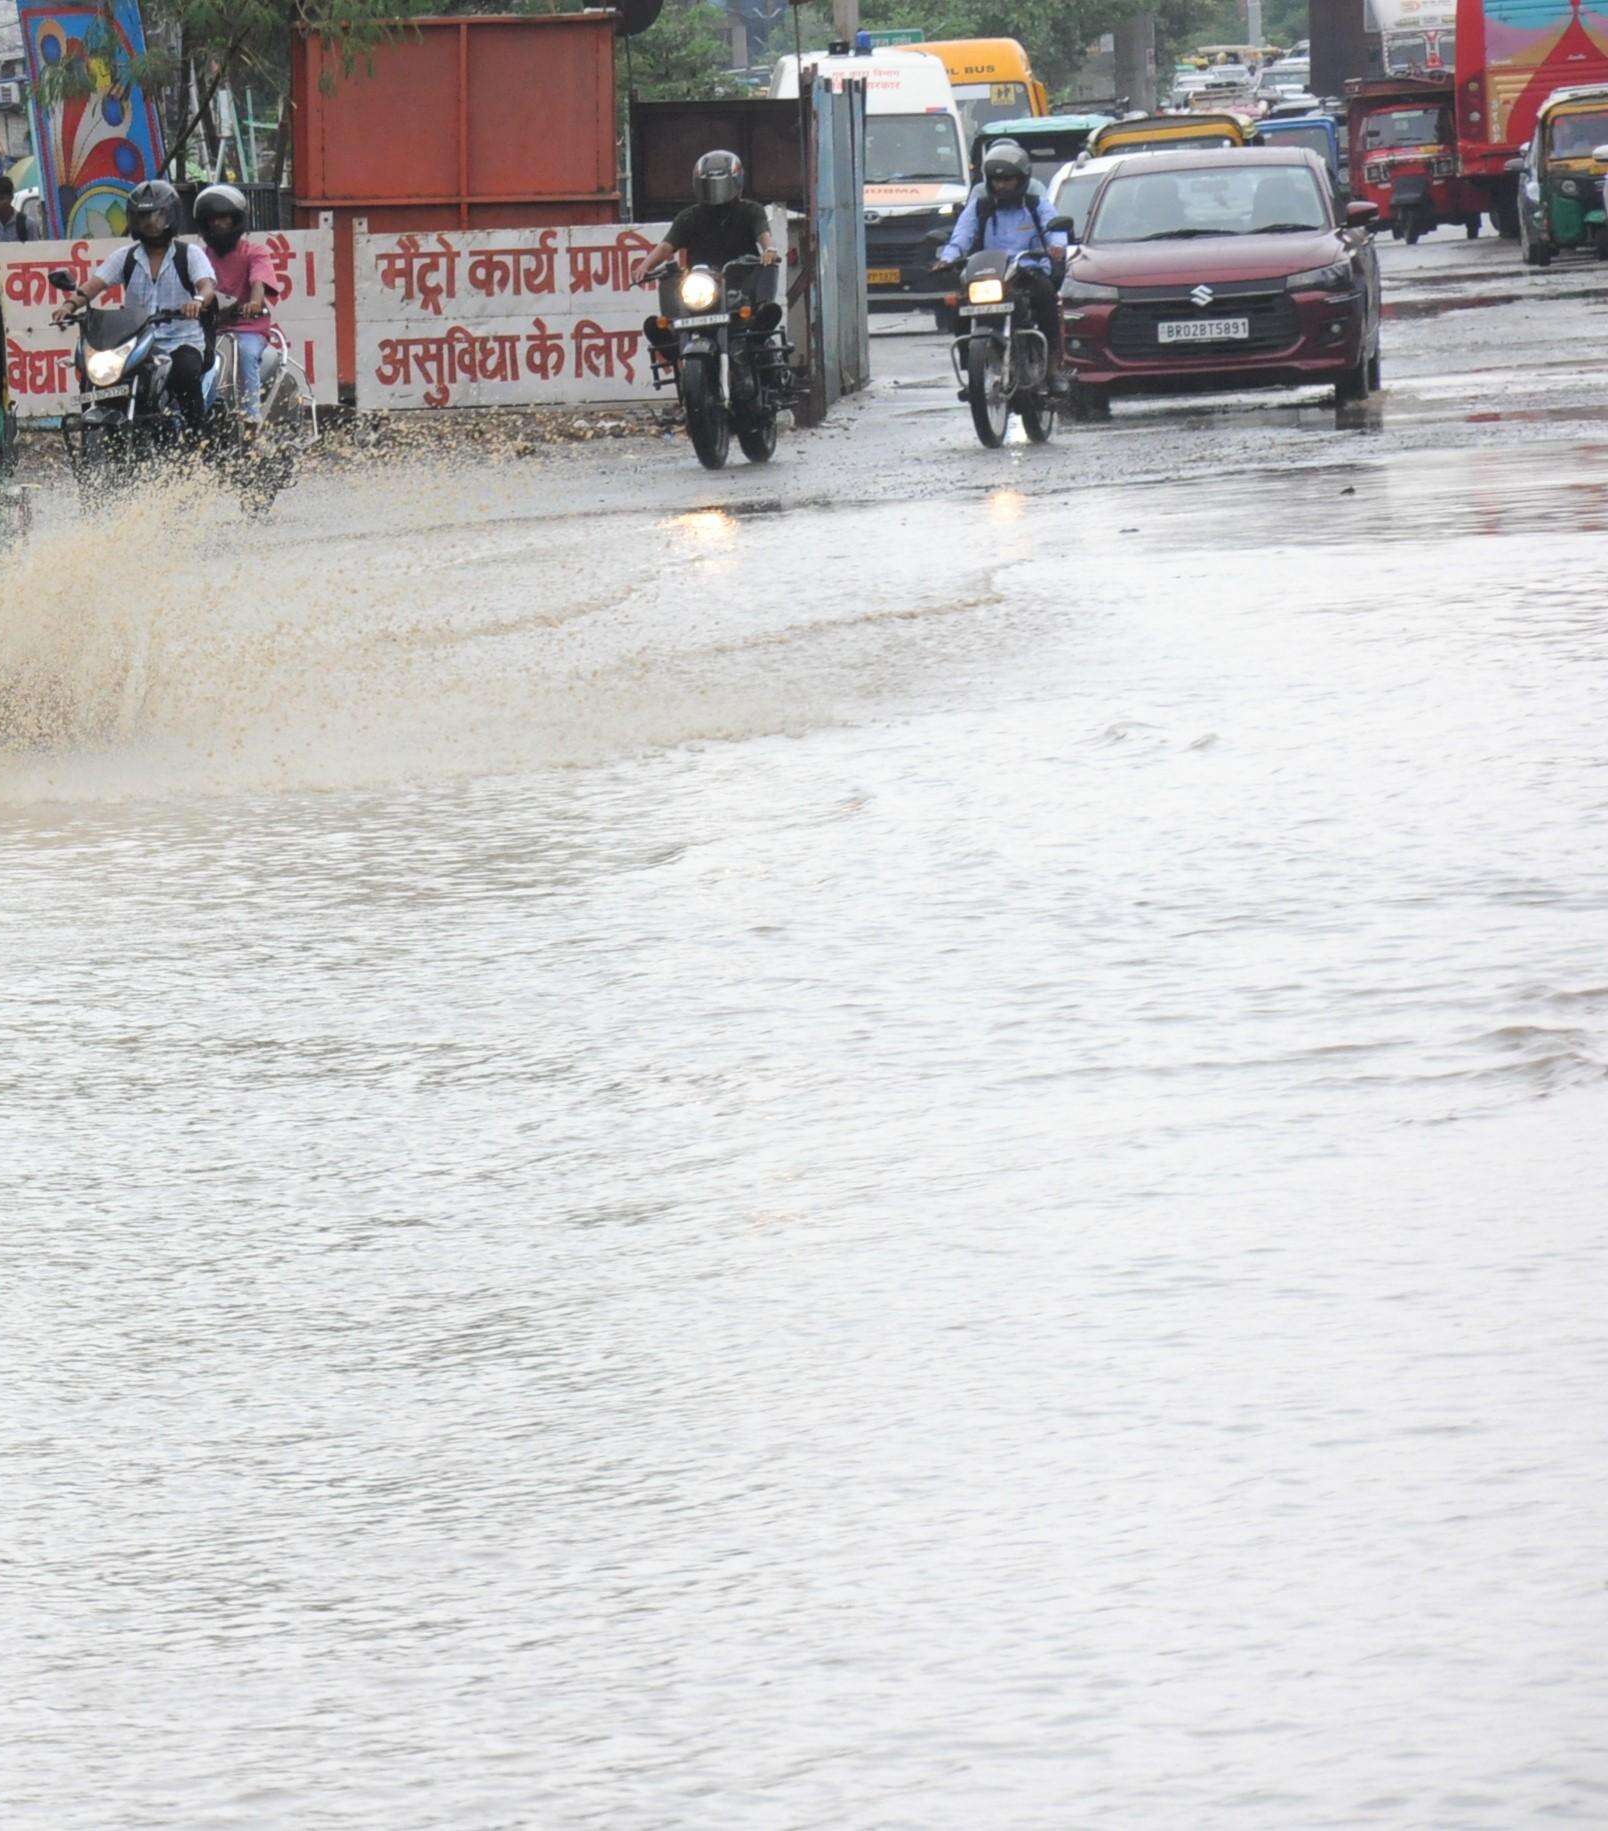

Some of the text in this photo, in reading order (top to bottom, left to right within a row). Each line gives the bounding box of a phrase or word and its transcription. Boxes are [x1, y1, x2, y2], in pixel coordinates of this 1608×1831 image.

[965, 65, 995, 74] BUS
[468, 230, 558, 297] कार्य
[1167, 321, 1248, 338] BR02BT5891
[375, 325, 521, 407] असुविधा
[525, 316, 566, 381] के
[570, 319, 643, 385] लिए
